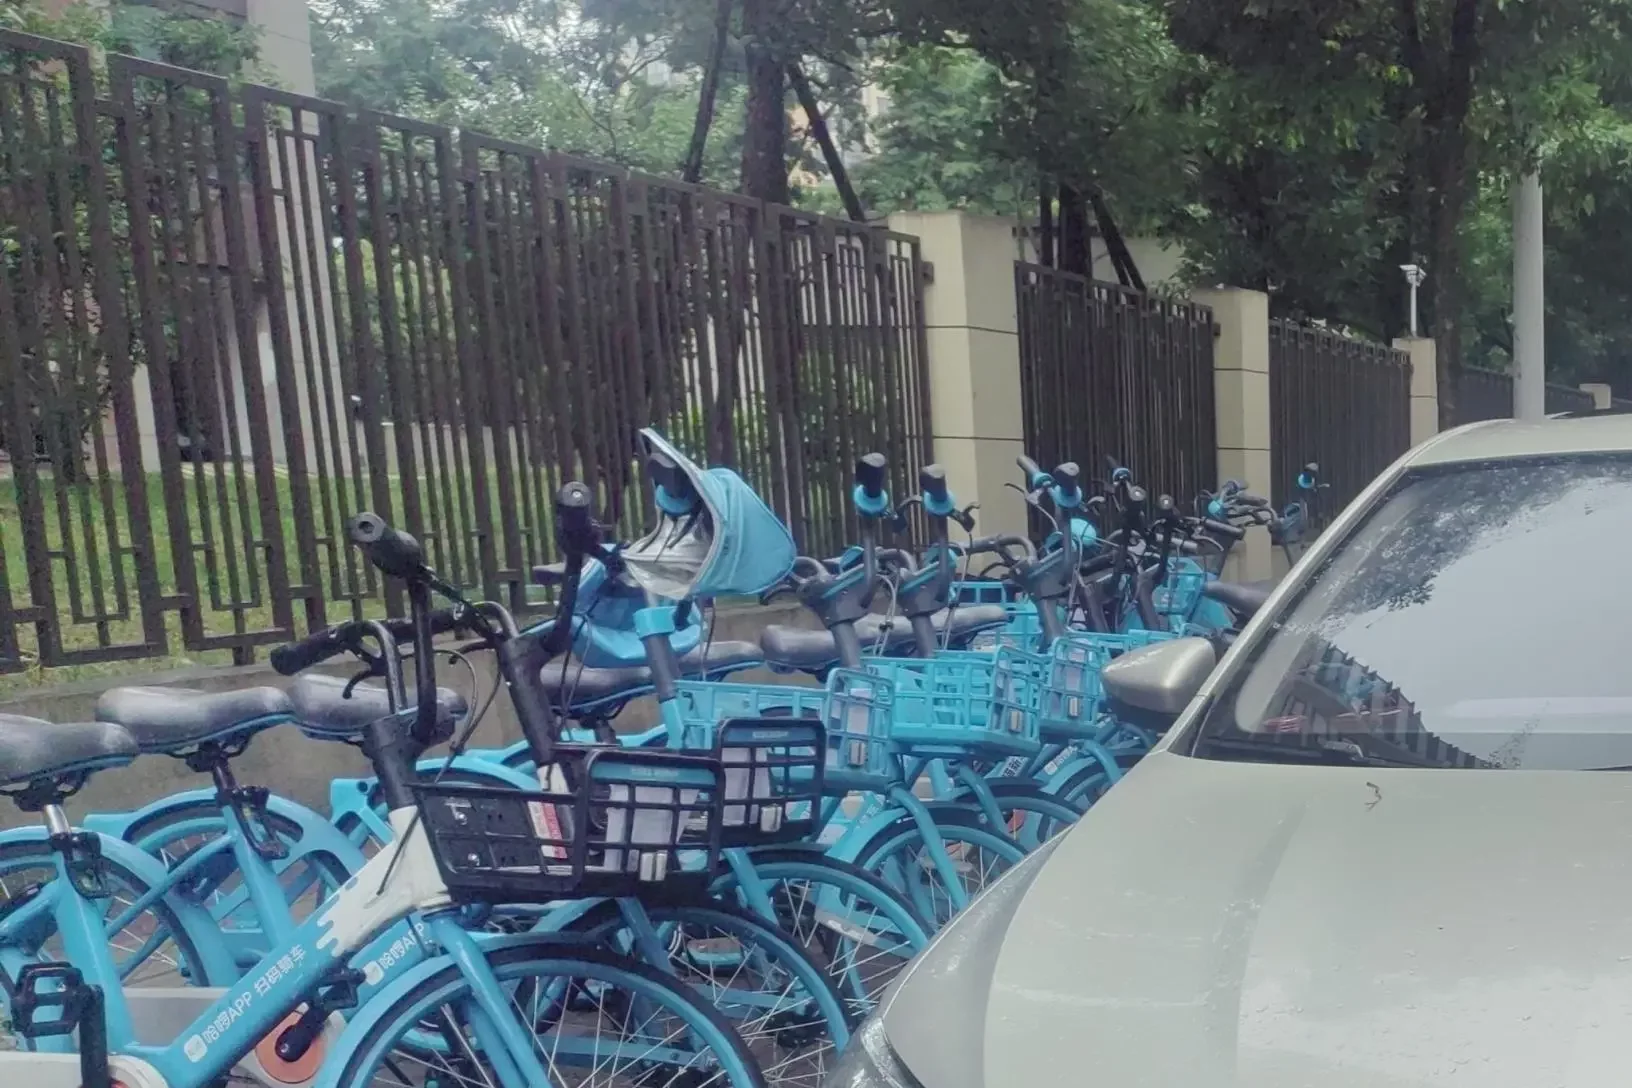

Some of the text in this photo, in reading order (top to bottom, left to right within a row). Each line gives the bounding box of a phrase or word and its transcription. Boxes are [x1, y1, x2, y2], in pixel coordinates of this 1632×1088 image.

[201, 944, 306, 1044] 哈啰APP 扫码骑车
